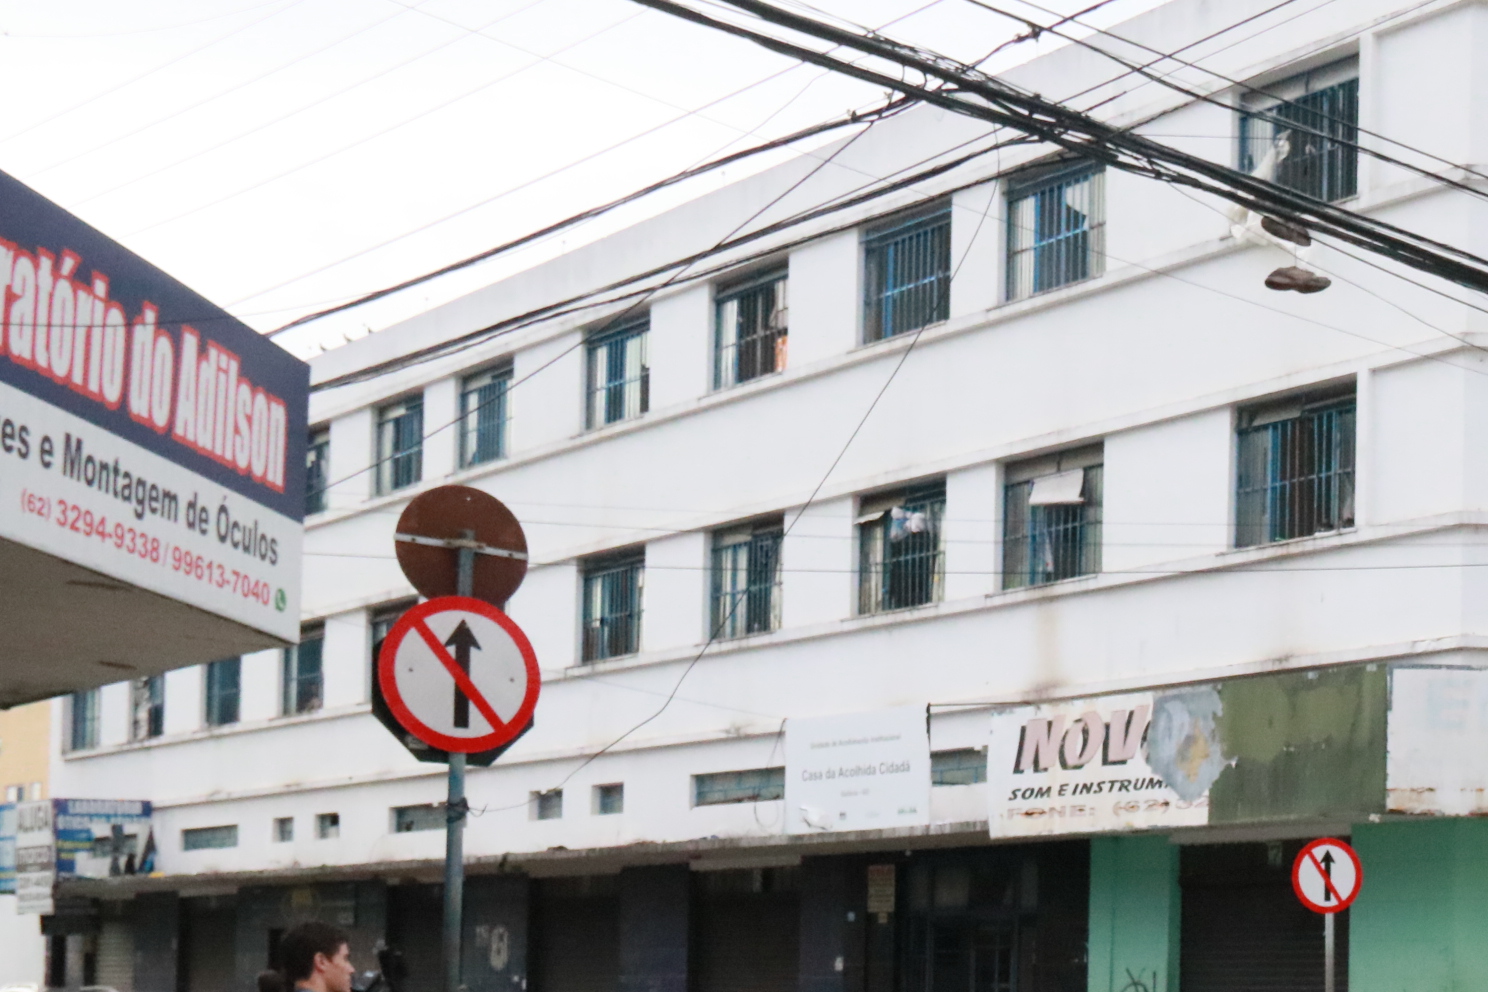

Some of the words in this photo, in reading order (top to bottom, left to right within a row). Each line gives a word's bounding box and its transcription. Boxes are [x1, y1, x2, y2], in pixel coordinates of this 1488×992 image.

[128, 303, 175, 431] do
[173, 327, 287, 491] Adilson
[40, 435, 54, 469] e
[62, 432, 178, 523] Montagem
[186, 492, 209, 535] de
[217, 494, 278, 566] Óculos
[20, 488, 52, 521] (62)
[56, 499, 160, 562] 3294-9338
[172, 546, 271, 605] 99613-7040
[801, 769, 823, 782] Casa
[825, 768, 836, 780] da
[838, 764, 877, 778] Acolhida
[1013, 705, 1151, 775] NOV
[1008, 785, 1051, 801] SOM
[1058, 784, 1069, 796] E
[1072, 777, 1169, 796] INSTRUM
